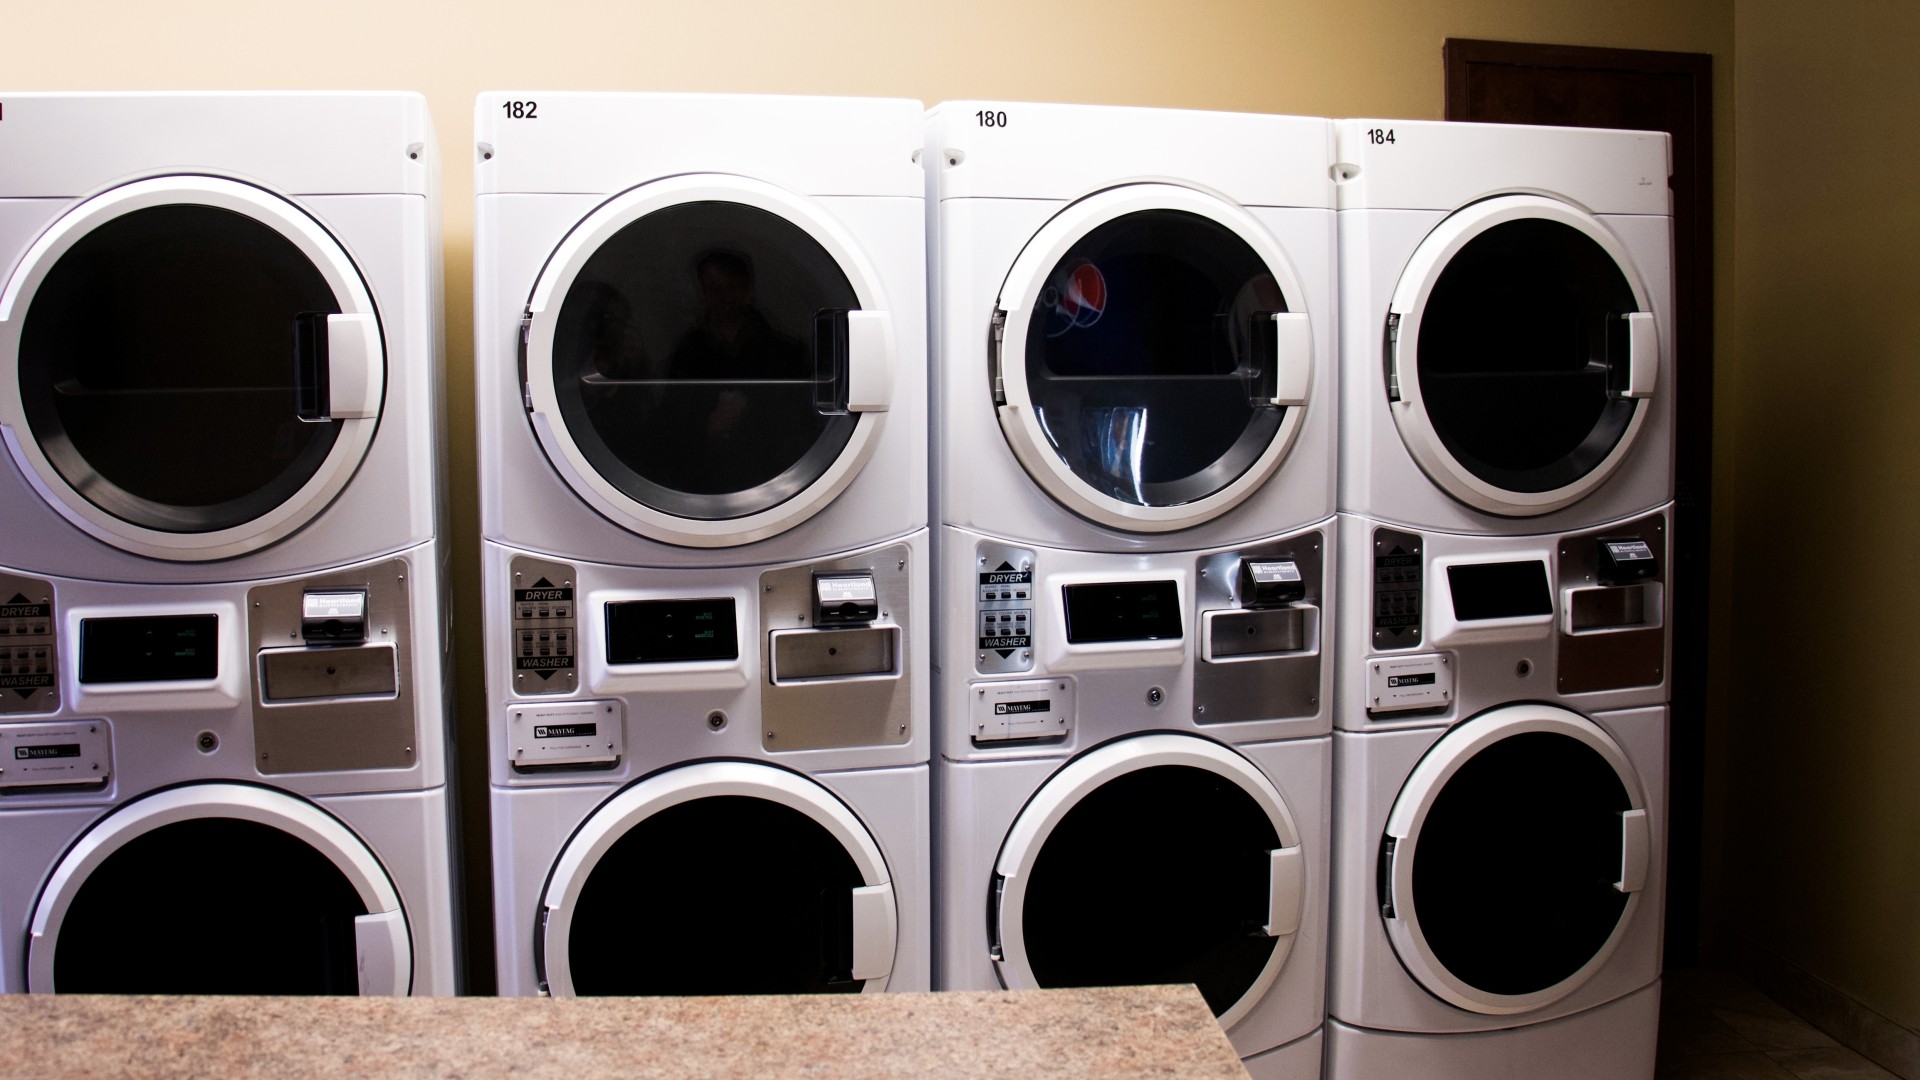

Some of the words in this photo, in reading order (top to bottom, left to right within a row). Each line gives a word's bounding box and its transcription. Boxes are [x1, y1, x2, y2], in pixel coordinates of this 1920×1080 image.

[502, 101, 538, 119] 182
[975, 110, 1007, 128] 180
[1367, 129, 1396, 145] 184
[1384, 557, 1413, 566] DRYER
[989, 573, 1024, 583] DRYER
[525, 590, 563, 600] DRYER
[1, 606, 40, 617] DRYER
[1379, 616, 1417, 627] WASHER
[984, 637, 1027, 647] WASHER
[522, 657, 569, 668] WASHER
[0, 675, 50, 687] WASHER
[1397, 676, 1419, 684] MAYTAG
[1007, 703, 1031, 712] MAYTAG
[547, 727, 575, 736] MAYTAG
[29, 748, 58, 757] MAYTAG
